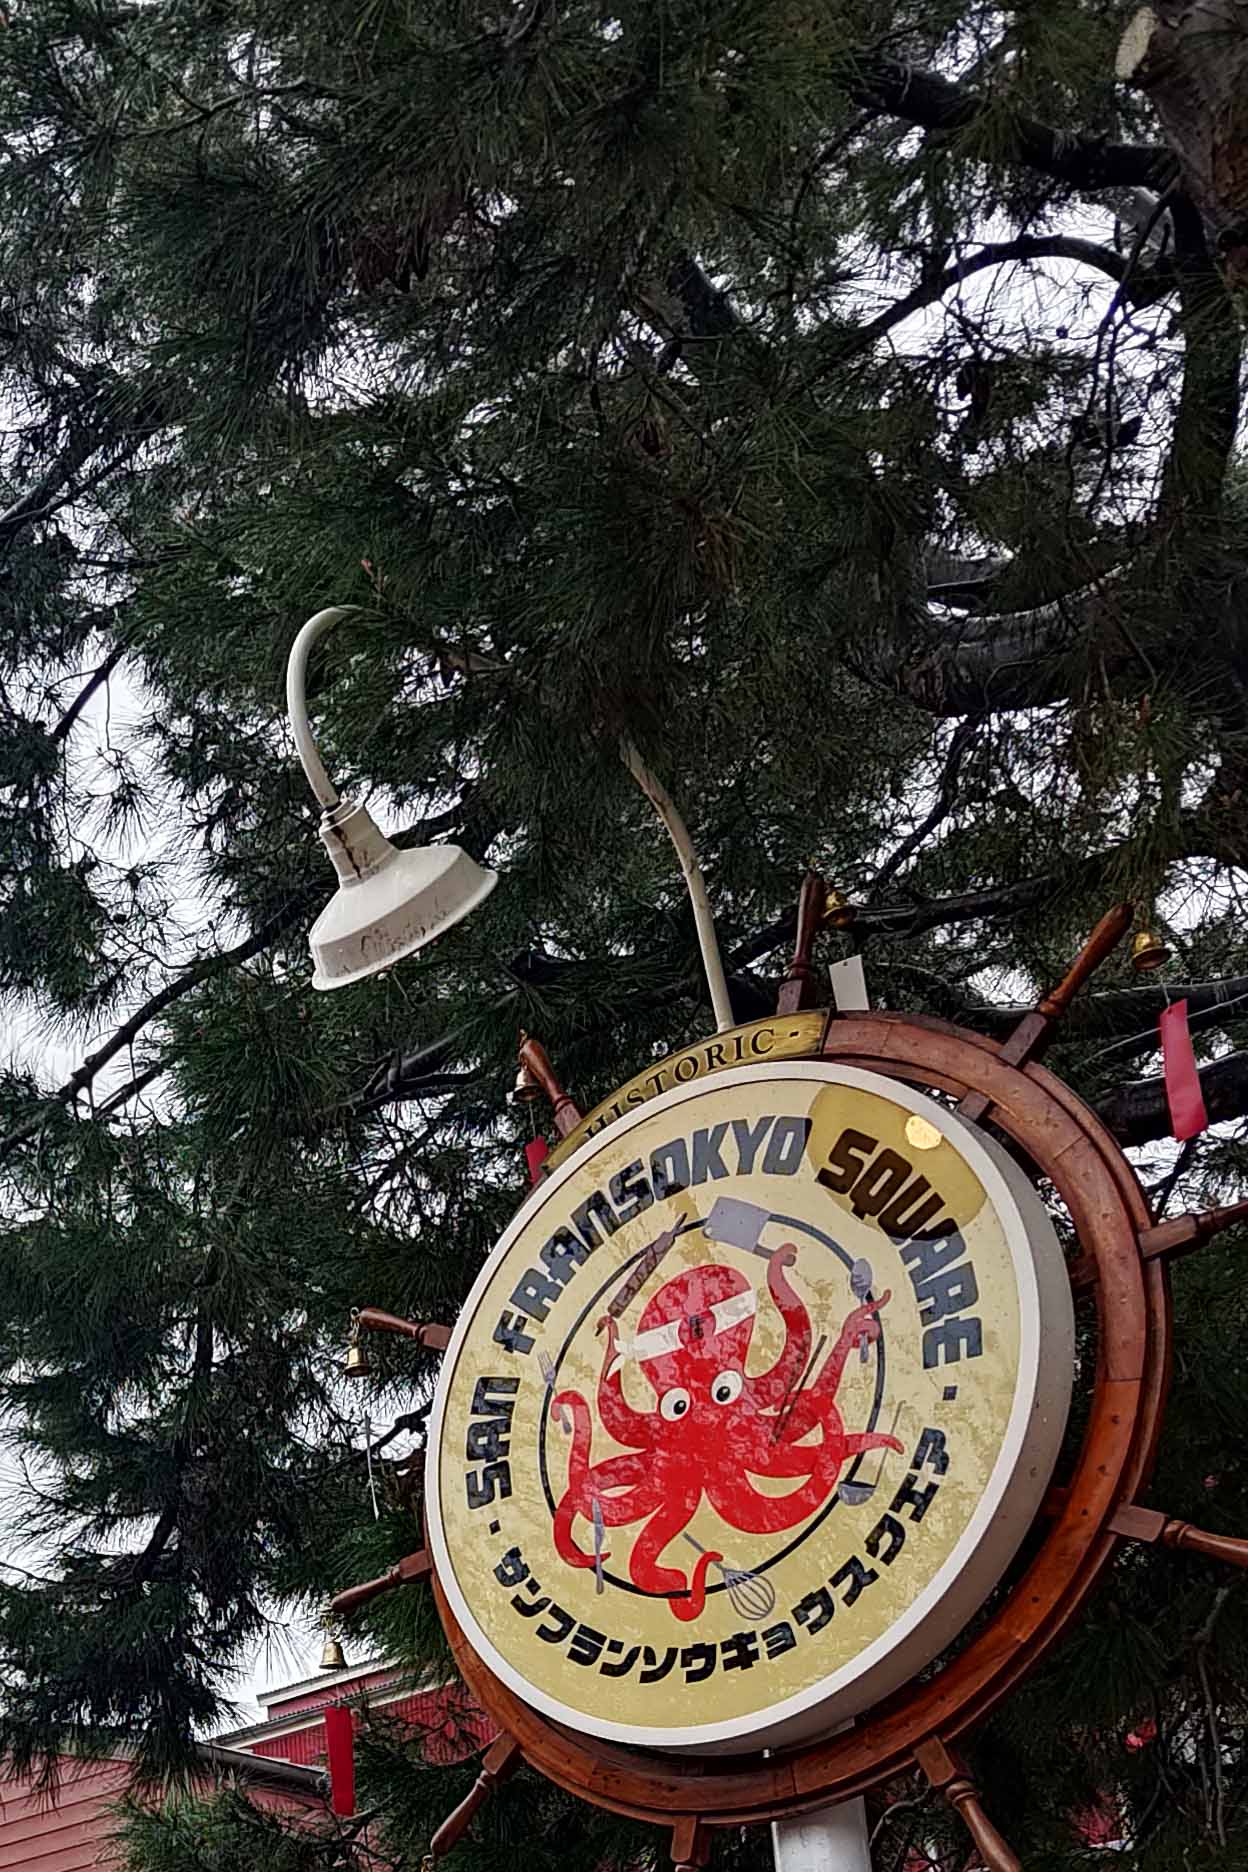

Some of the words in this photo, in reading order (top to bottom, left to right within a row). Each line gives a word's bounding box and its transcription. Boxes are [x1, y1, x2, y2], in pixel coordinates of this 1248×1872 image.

[585, 1028, 775, 1140] HISTORIC
[466, 1375, 520, 1511] SAN
[494, 1115, 813, 1355] FRANSOKYO
[814, 1127, 984, 1371] SQUARE
[492, 1427, 951, 1684] サンフランソウキョウスクエア
